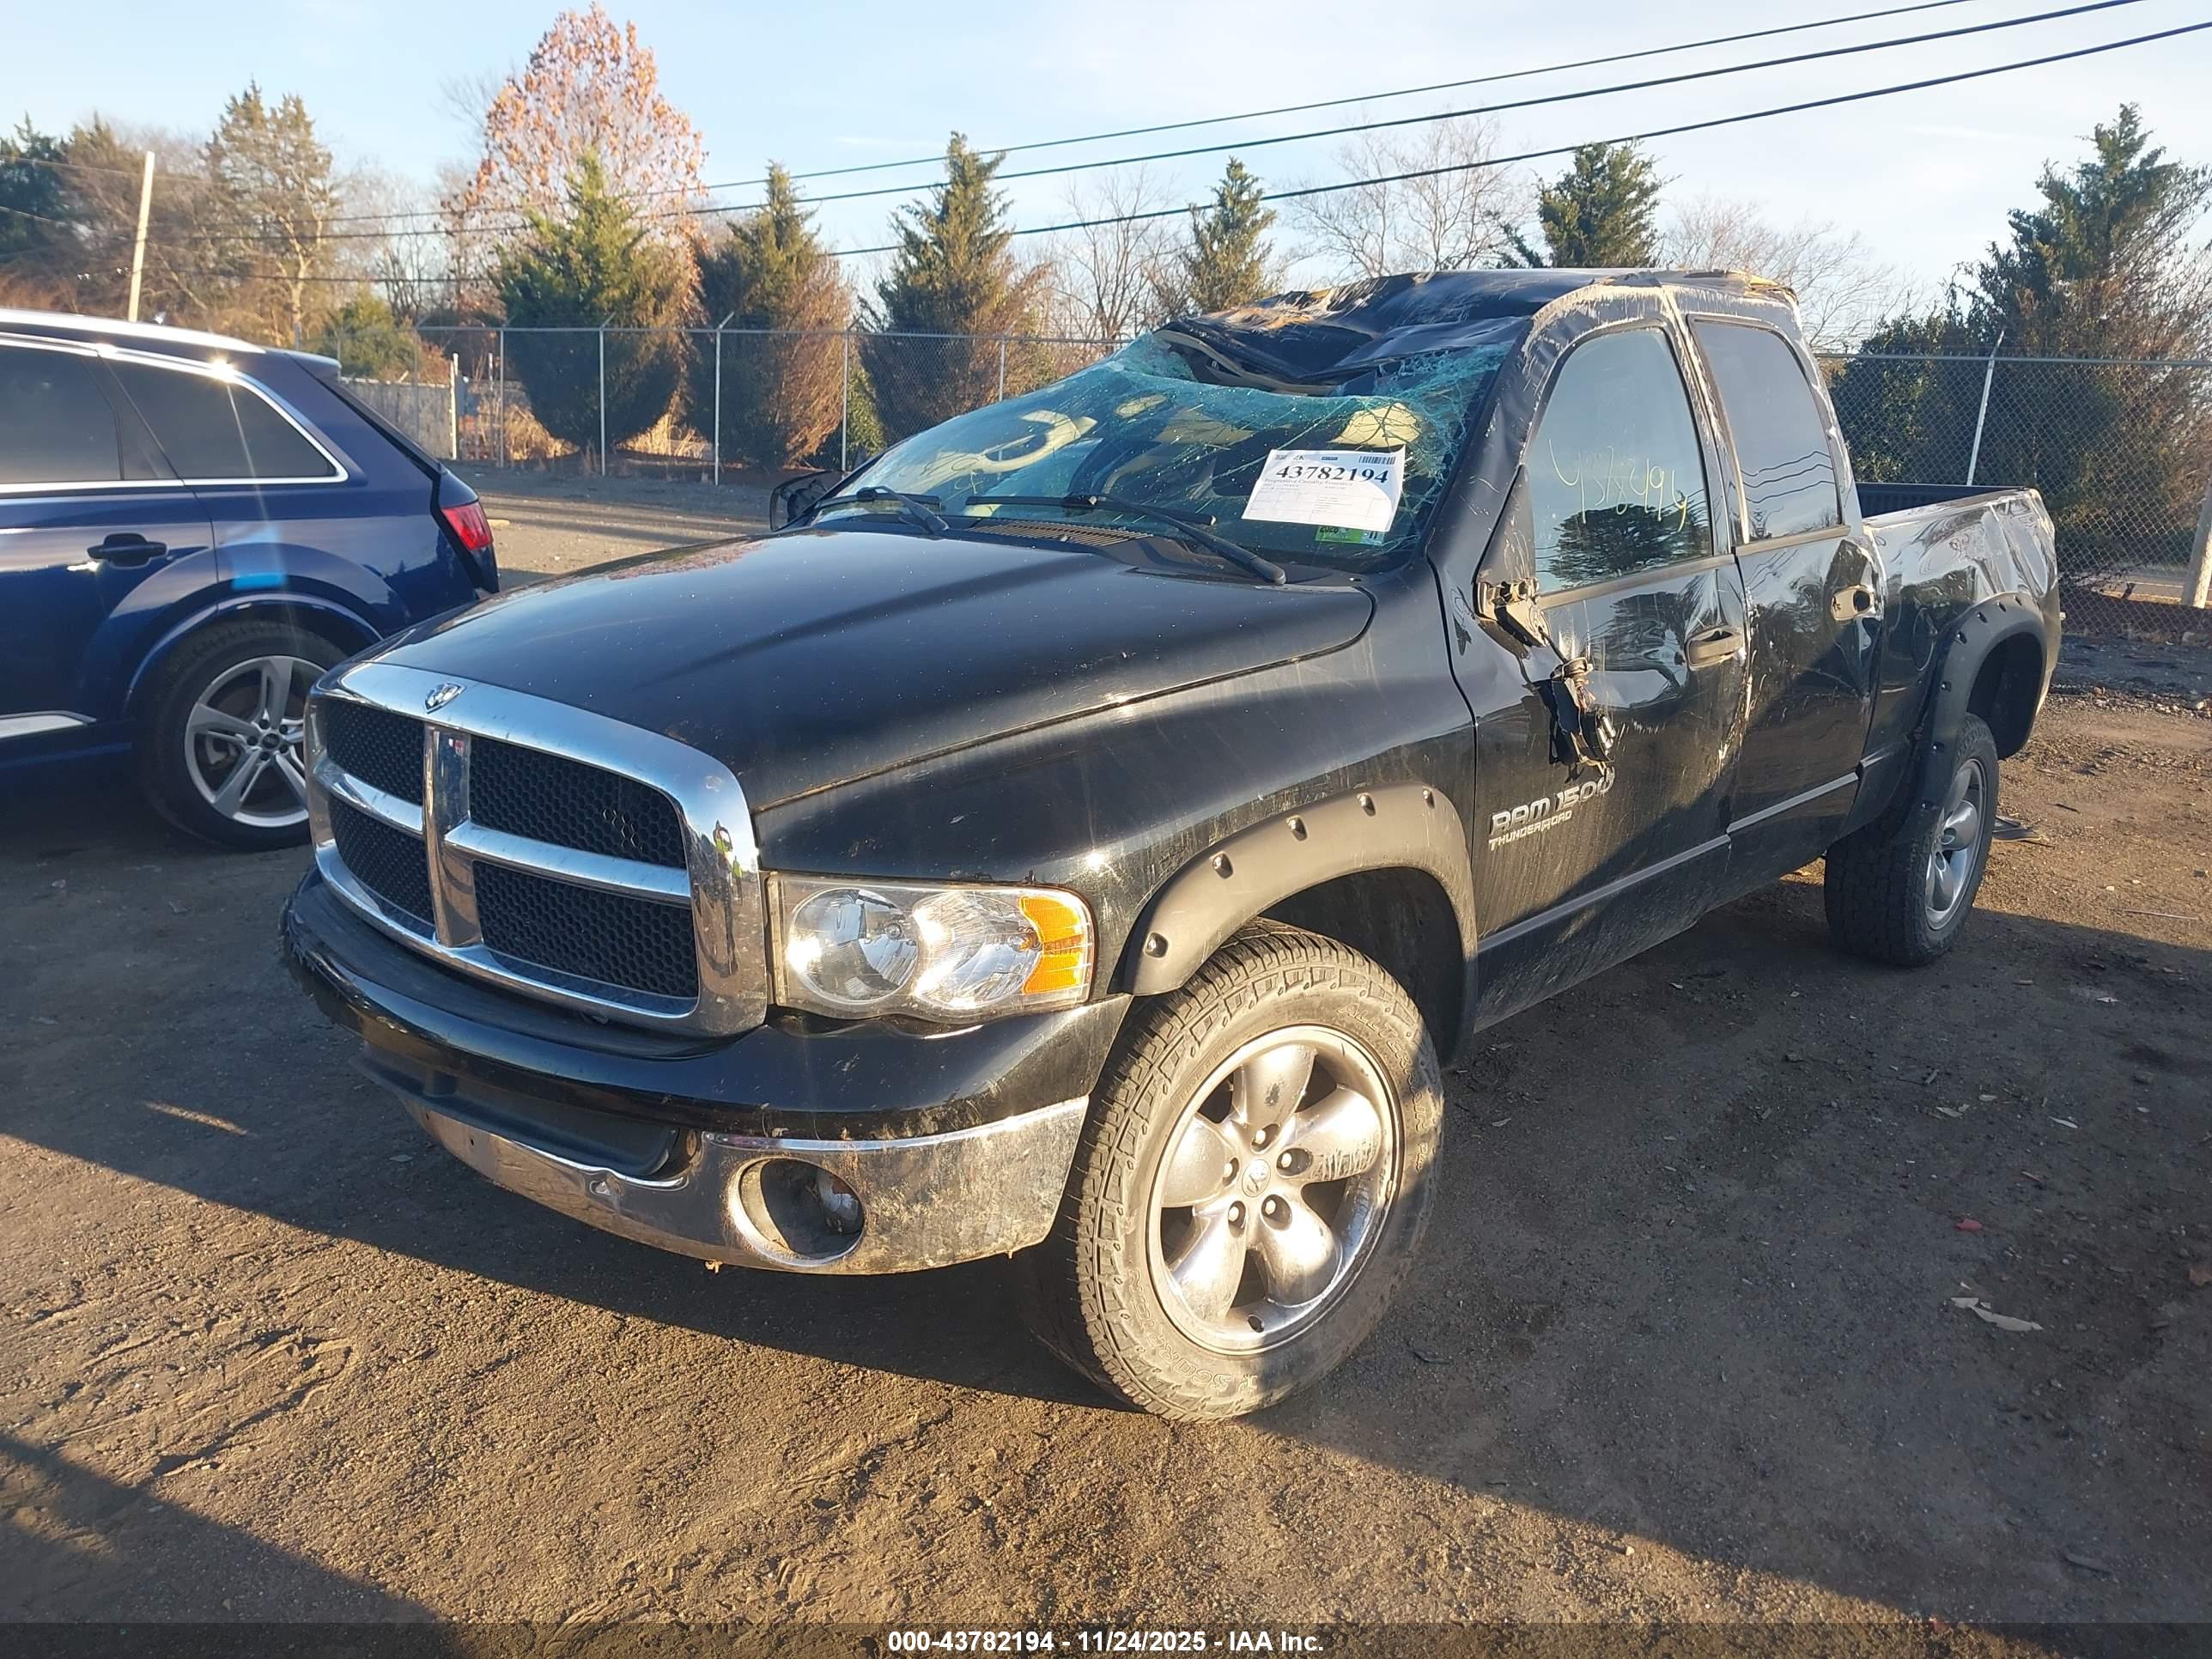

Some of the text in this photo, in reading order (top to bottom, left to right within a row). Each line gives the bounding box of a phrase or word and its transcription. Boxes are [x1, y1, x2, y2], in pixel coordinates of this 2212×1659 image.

[1275, 465, 1389, 483] 43782194
[1489, 769, 1616, 836] RAM 1500
[1488, 810, 1573, 851] THUNDERROAD
